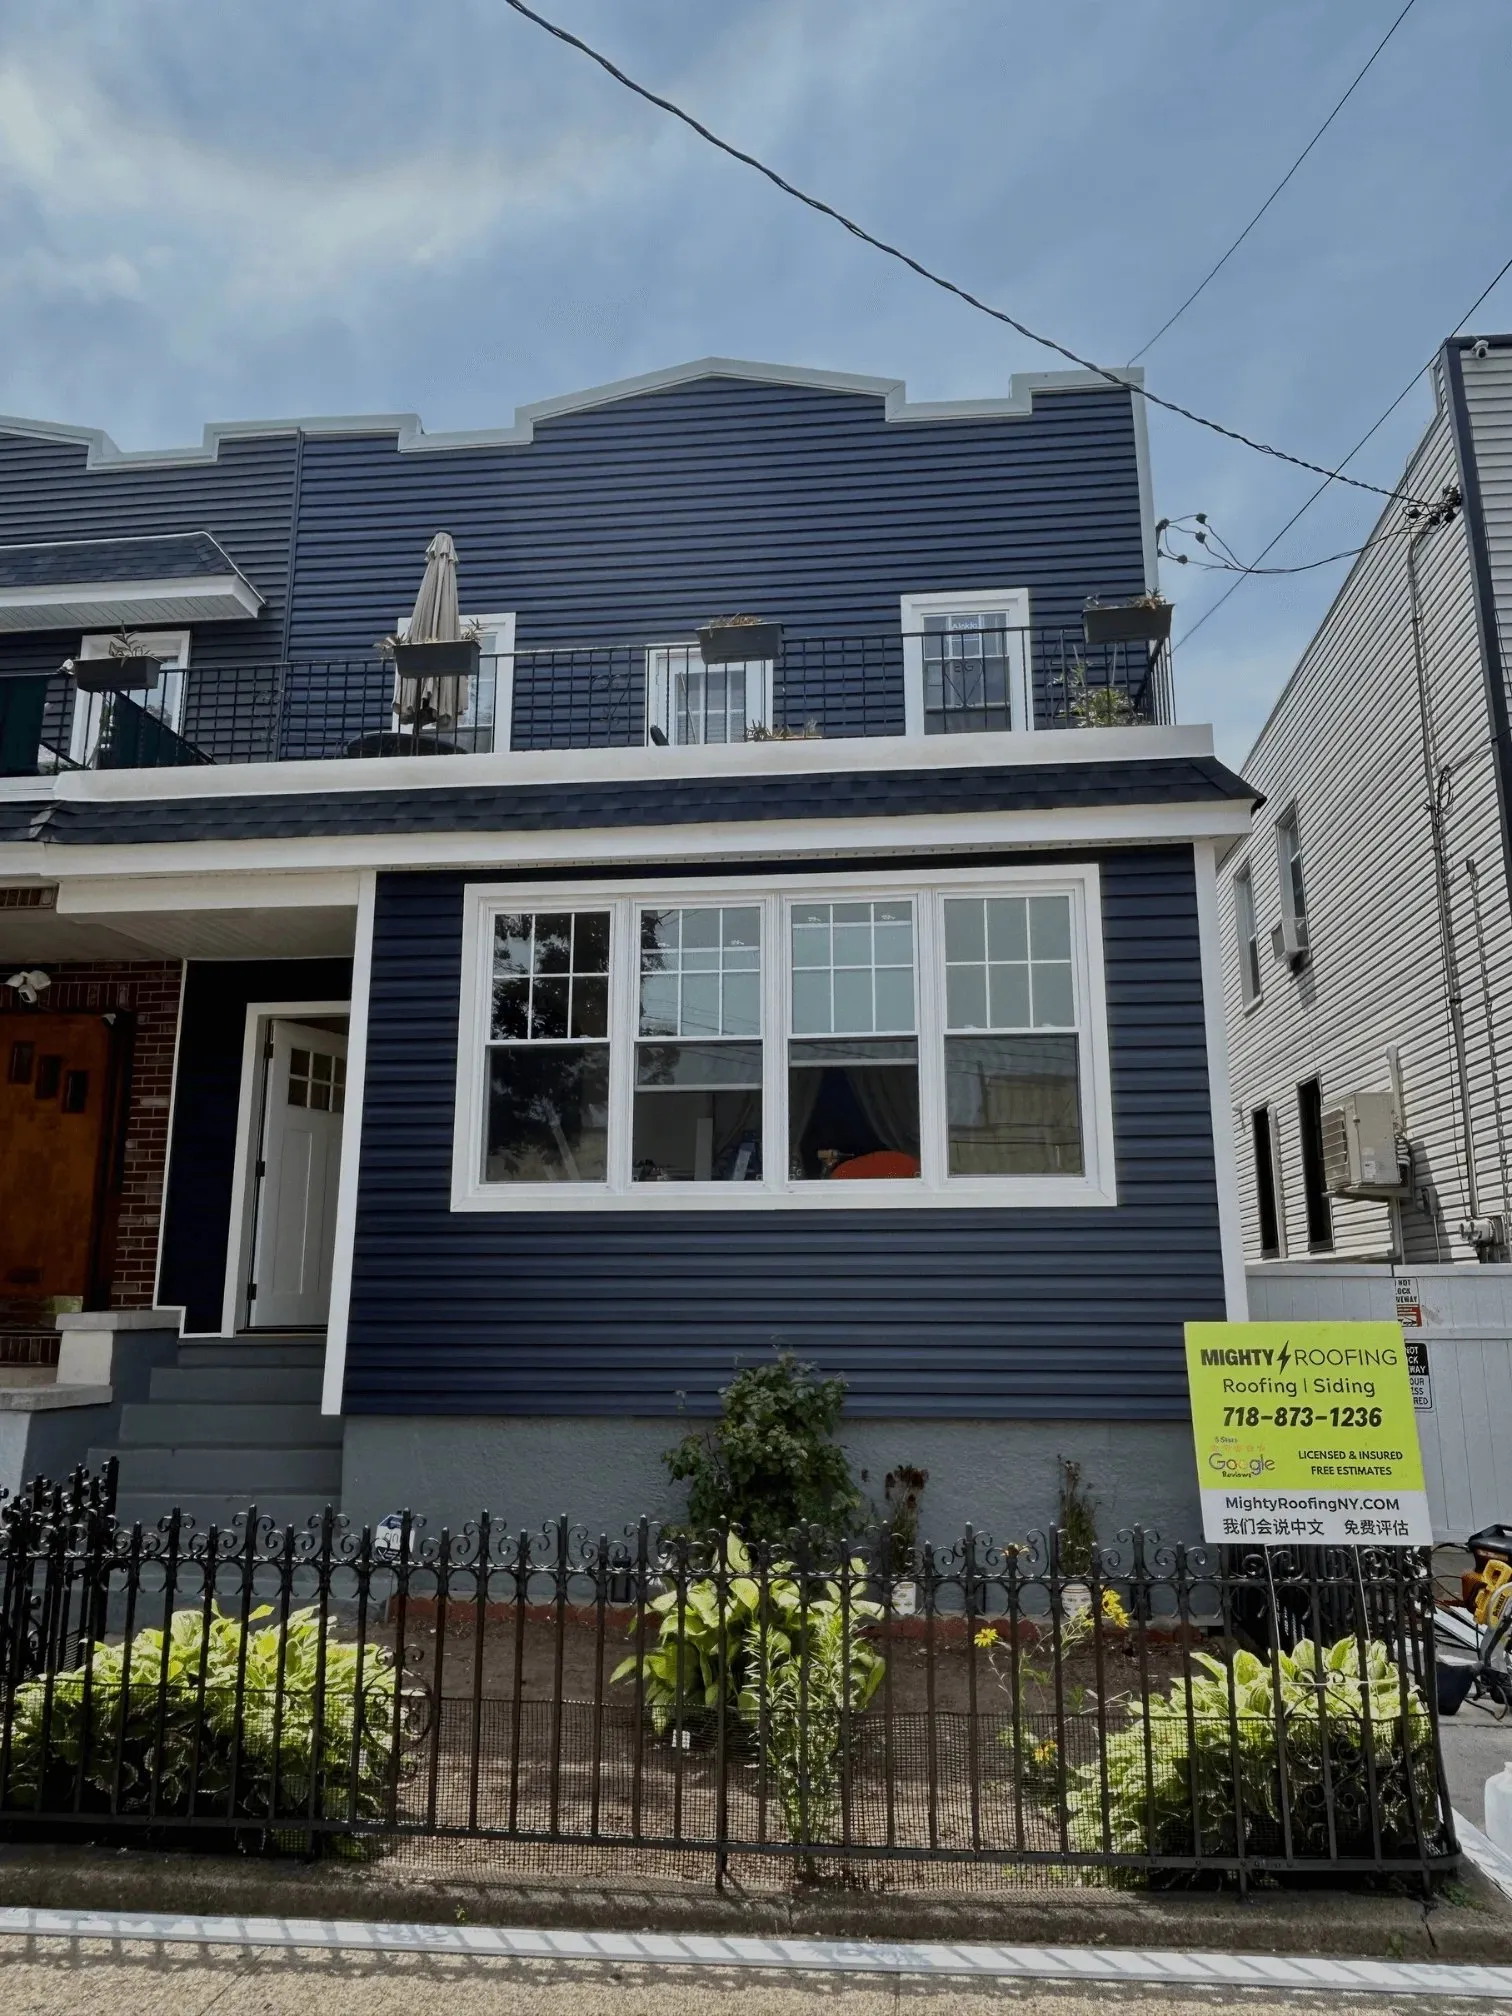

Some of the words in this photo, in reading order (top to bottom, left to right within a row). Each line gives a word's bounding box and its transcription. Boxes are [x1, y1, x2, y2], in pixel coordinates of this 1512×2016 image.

[1396, 1287, 1411, 1295] OCK
[1200, 1349, 1274, 1366] MIGHTY
[1294, 1348, 1398, 1366] ROOFING
[1222, 1377, 1297, 1398] Roofing
[1313, 1377, 1376, 1398] Siding
[1410, 1377, 1425, 1386] OUR
[1223, 1406, 1383, 1427] 718-873-1236
[1208, 1452, 1276, 1475] Google
[1298, 1450, 1346, 1460] LICENSED
[1348, 1450, 1357, 1460] &
[1359, 1450, 1403, 1460] INSURED
[1311, 1465, 1335, 1475] FREE
[1336, 1465, 1392, 1476] ESTIMATES
[1225, 1495, 1400, 1512] MightyRoofingNY.COM
[1223, 1518, 1325, 1536] 我们会说中文
[1344, 1519, 1409, 1537] 免费评估
